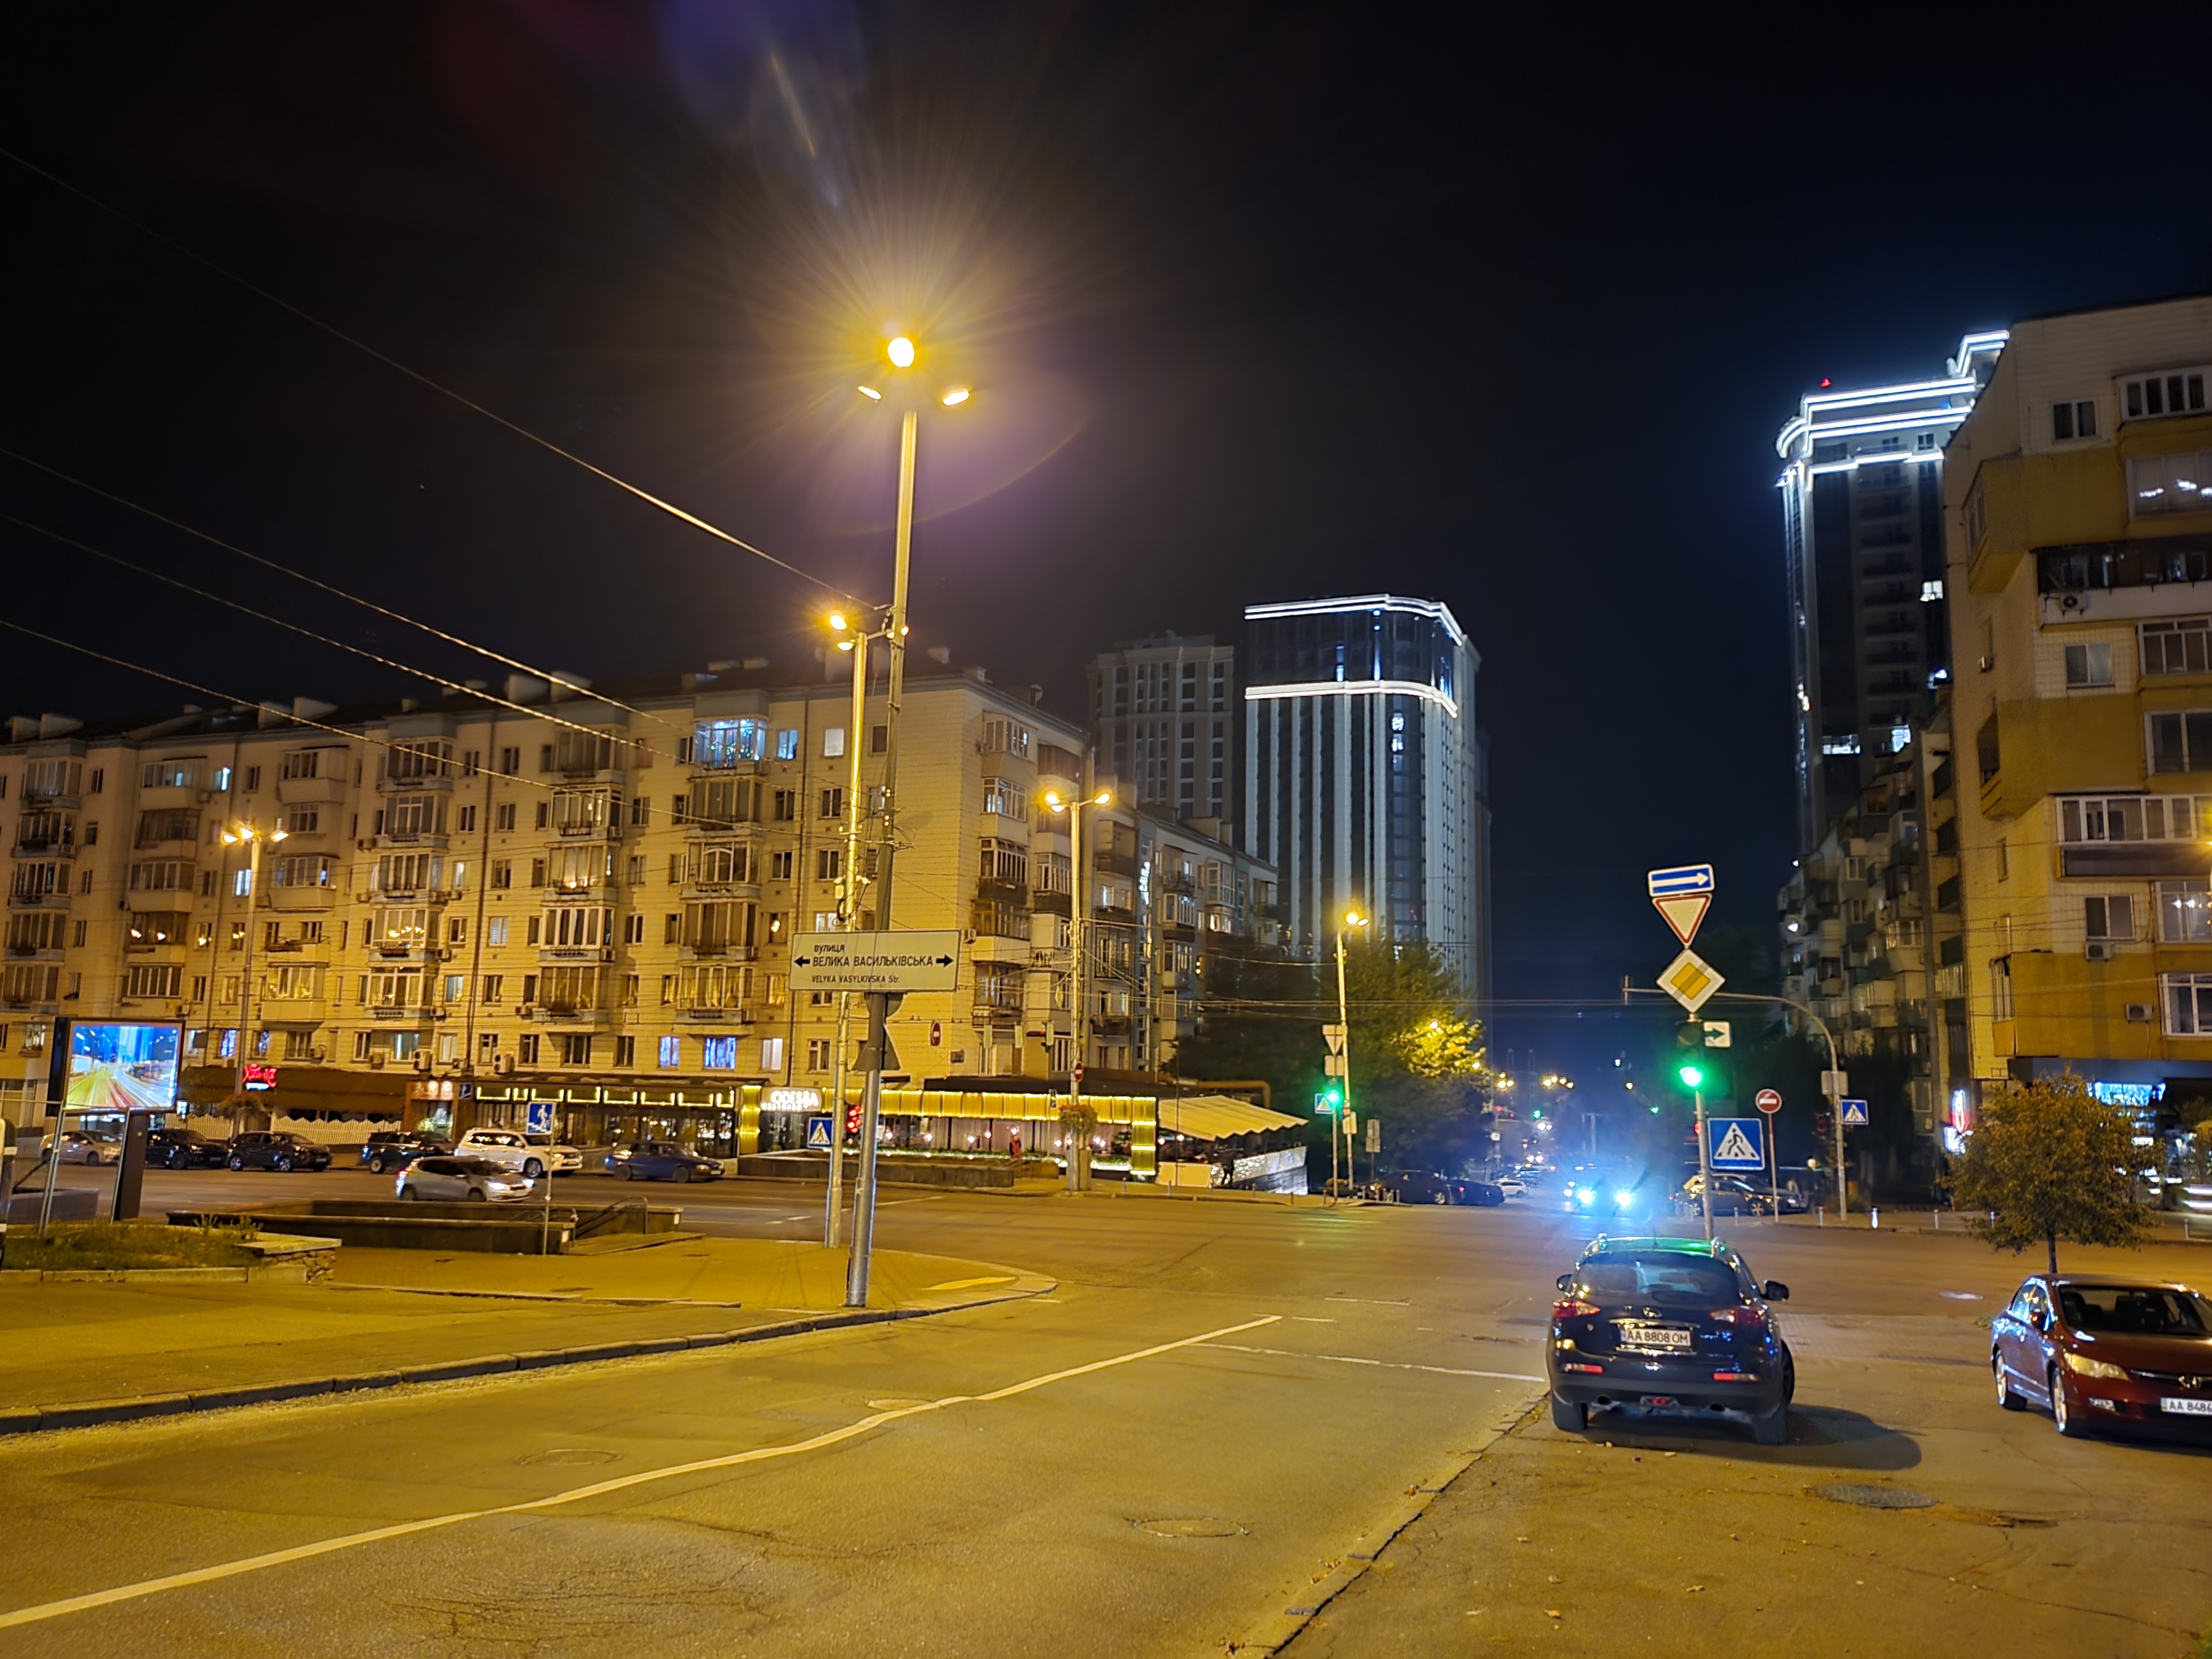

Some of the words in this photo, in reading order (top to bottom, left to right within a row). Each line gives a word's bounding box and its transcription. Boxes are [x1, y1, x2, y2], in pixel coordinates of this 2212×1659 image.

[813, 956, 849, 967] ВЕЛИКА
[853, 955, 933, 967] ВАСИЛЬКІВСЬКА
[839, 975, 886, 983] VASYLKIVSKA
[888, 975, 900, 983] Str.
[1627, 1331, 1642, 1341] AA
[1644, 1332, 1670, 1343] 8808
[1672, 1333, 1688, 1344] OM
[2169, 1401, 2184, 1411] AA
[2187, 1402, 2212, 1412] 8486
